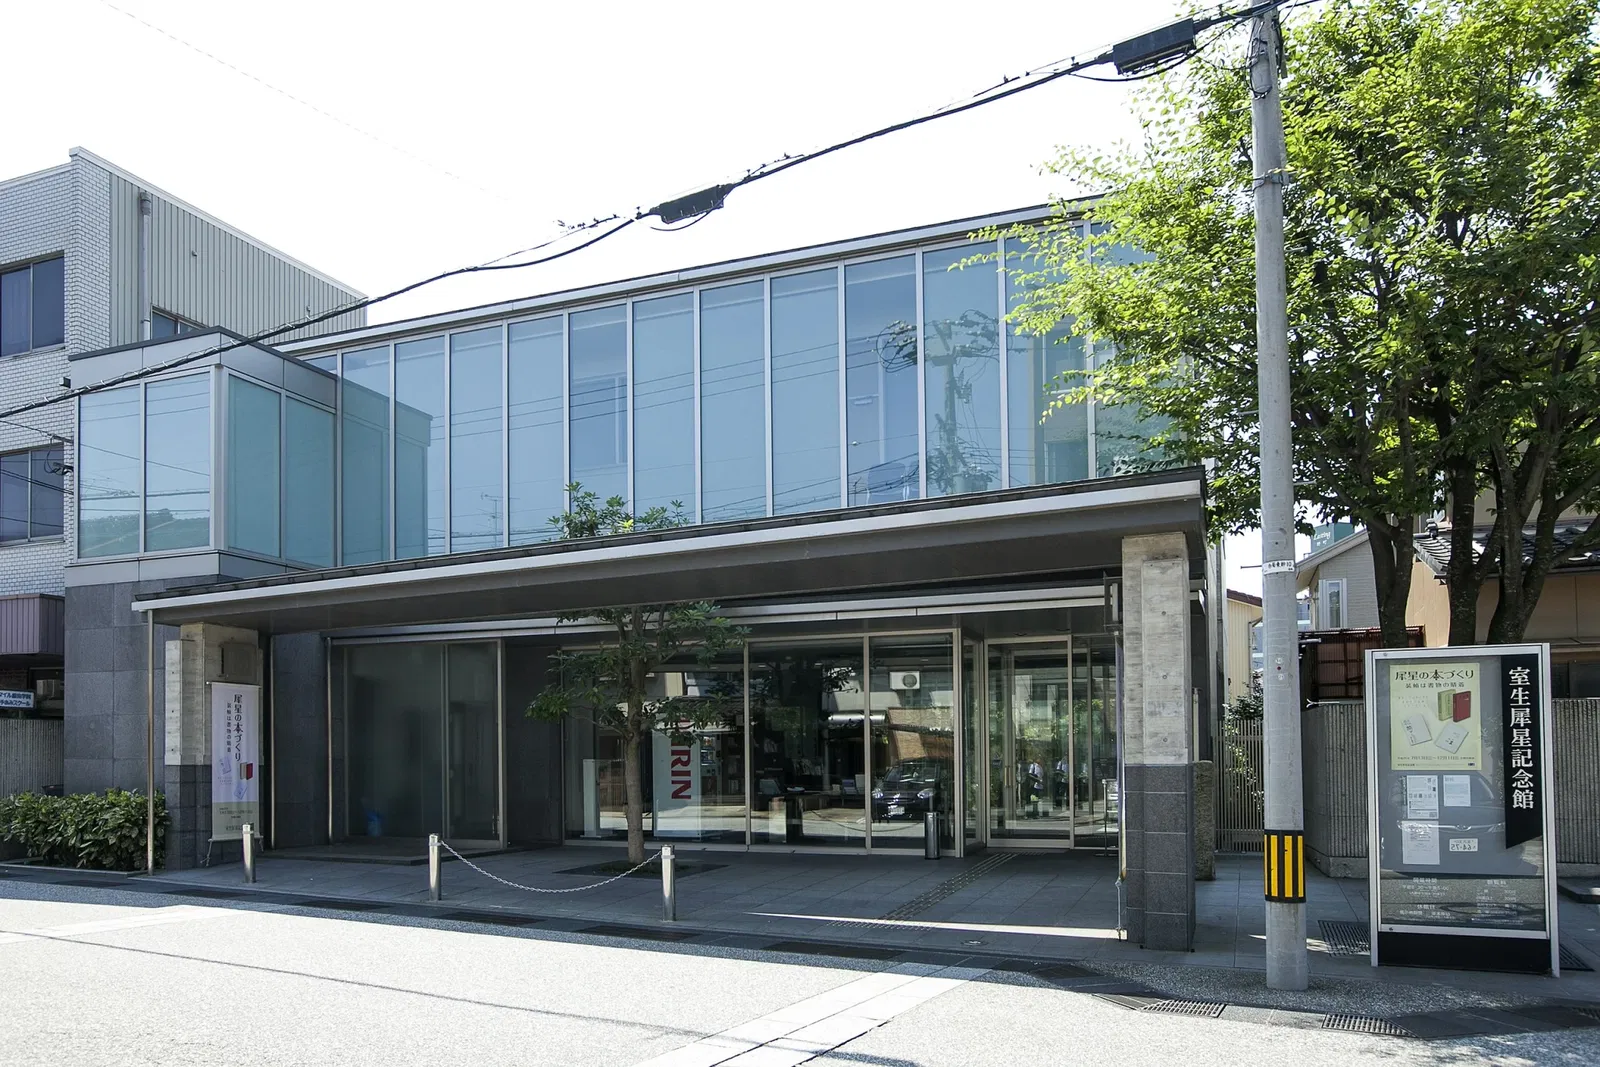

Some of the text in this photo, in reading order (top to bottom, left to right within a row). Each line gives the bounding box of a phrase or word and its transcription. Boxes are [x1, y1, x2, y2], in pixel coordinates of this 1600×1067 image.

[1395, 669, 1474, 681] 犀星の本づくり
[233, 693, 244, 762] 犀星の本づくり
[1509, 666, 1534, 809] 室生犀星記念館
